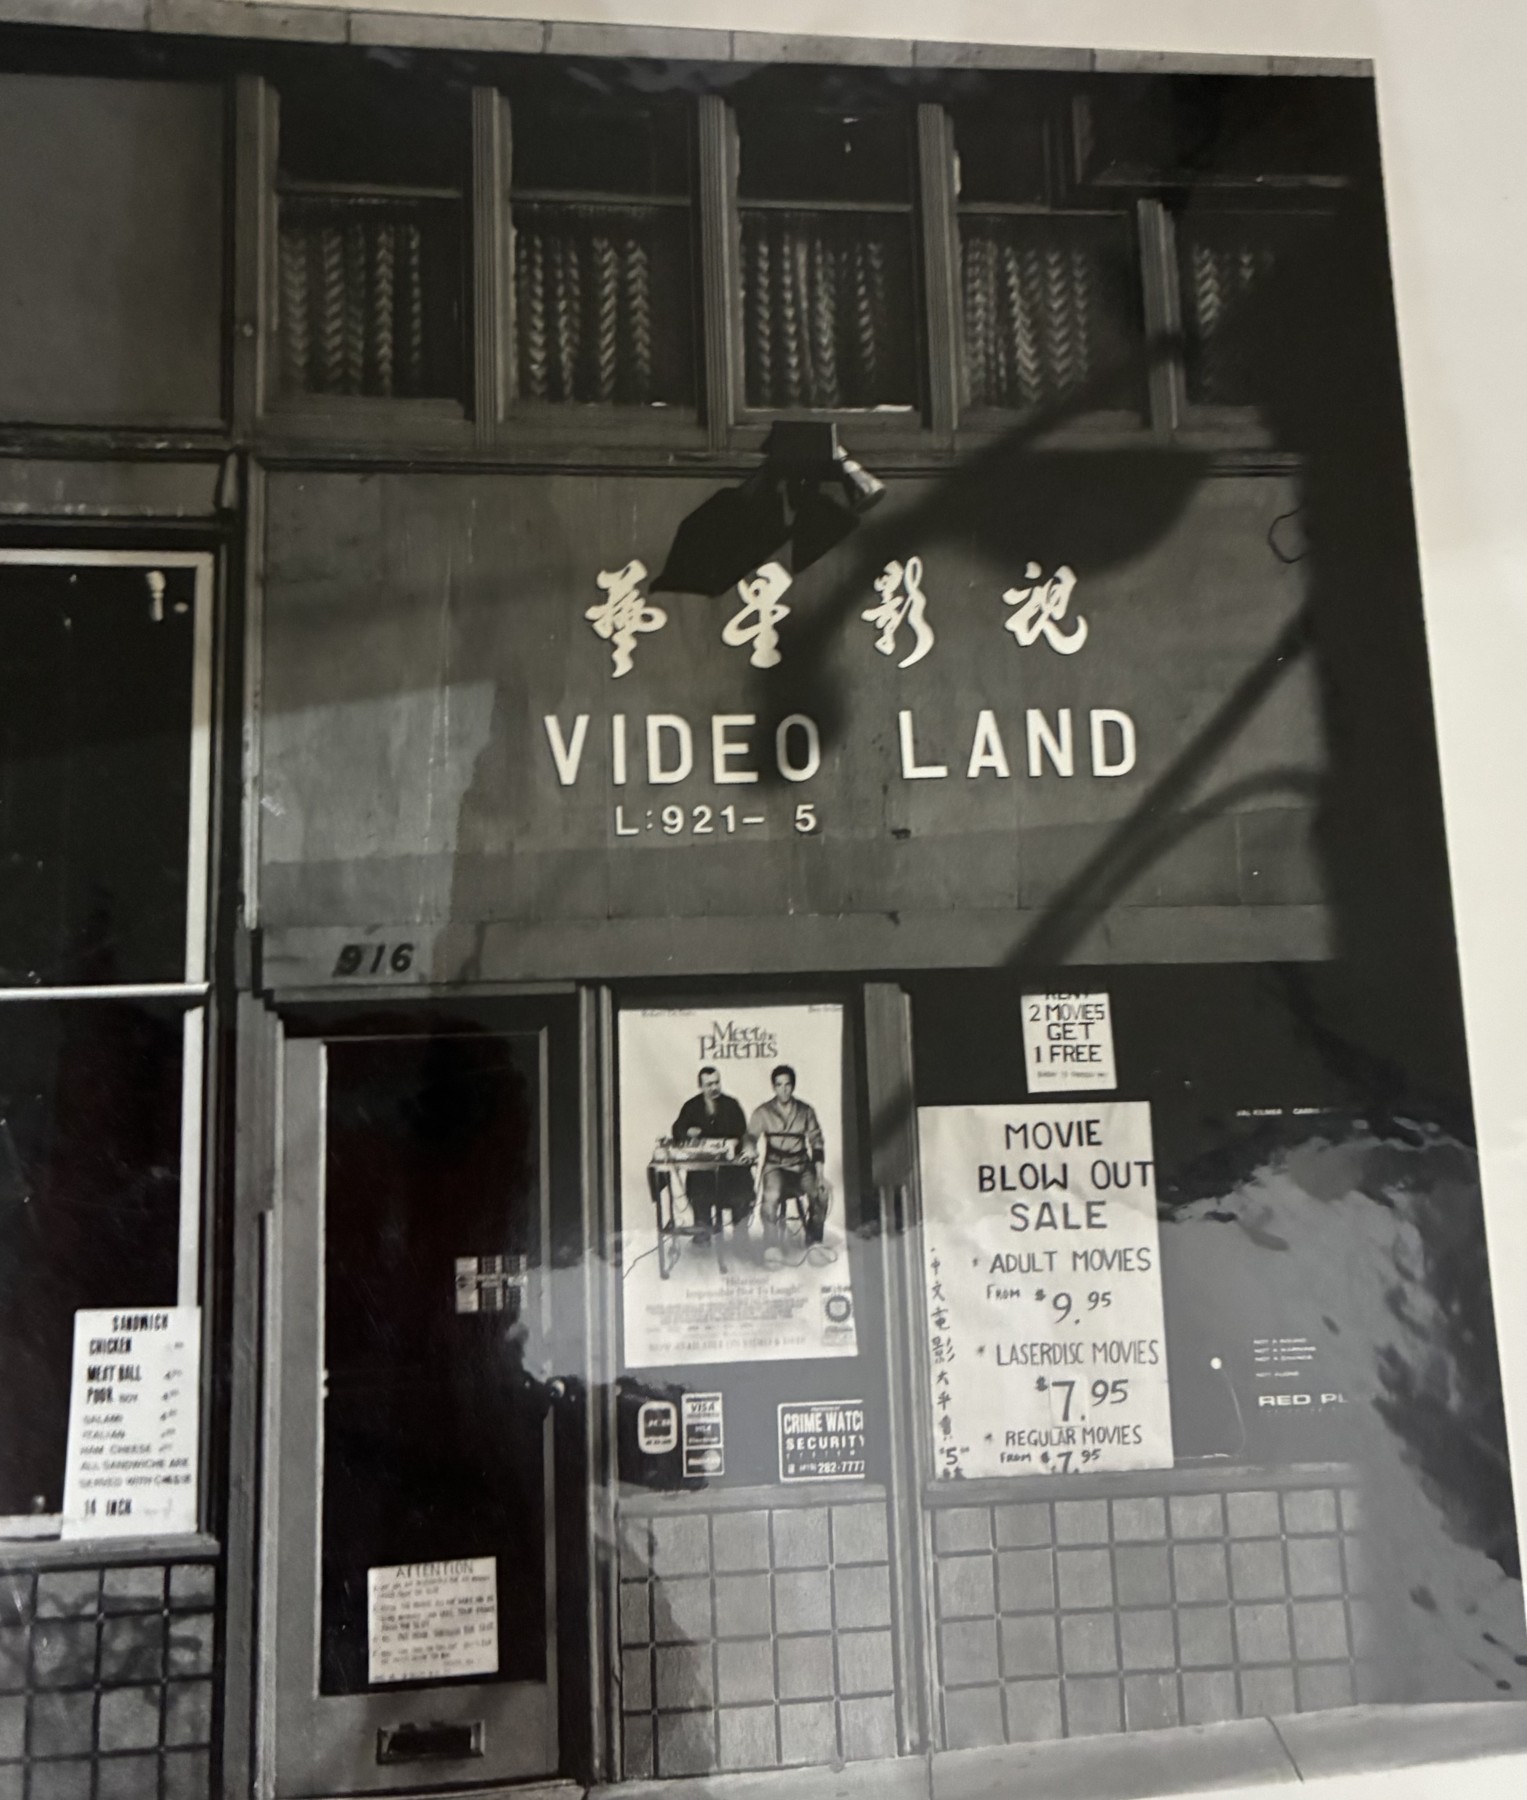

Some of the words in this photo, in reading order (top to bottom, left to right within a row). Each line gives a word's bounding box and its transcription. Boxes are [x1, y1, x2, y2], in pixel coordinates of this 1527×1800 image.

[544, 713, 821, 786] VIDEO
[899, 709, 1137, 780] LAND
[795, 803, 817, 833] 5
[334, 943, 414, 977] 916
[1029, 1003, 1042, 1022] 2
[1045, 1003, 1105, 1021] MOVIES
[712, 1020, 760, 1042] Meet
[1047, 1021, 1095, 1041] GET
[697, 1035, 778, 1060] Parents
[1033, 1045, 1041, 1063] 1
[1049, 1044, 1102, 1063] FREE
[1004, 1119, 1103, 1150] MOVIE
[978, 1162, 1068, 1193] BLOW
[1090, 1159, 1154, 1190] OUT
[1009, 1200, 1108, 1232] SALE
[989, 1251, 1058, 1274] ADULT
[1072, 1247, 1151, 1272] MOVIES
[112, 1313, 169, 1332] SANDWICH
[89, 1337, 132, 1356] CHICKEN
[996, 1343, 1084, 1366] LASERDISC
[1092, 1340, 1159, 1365] MOVIES
[87, 1364, 115, 1383] MEAT
[119, 1364, 142, 1382] BALL
[691, 1402, 715, 1413] VISA
[1258, 1393, 1311, 1407] RED
[783, 1412, 823, 1435] CRIME
[1005, 1428, 1076, 1447] REGULAR
[1082, 1425, 1142, 1445] MOVIES
[106, 1499, 133, 1517] INCH
[396, 1560, 474, 1578] ATTENTION
